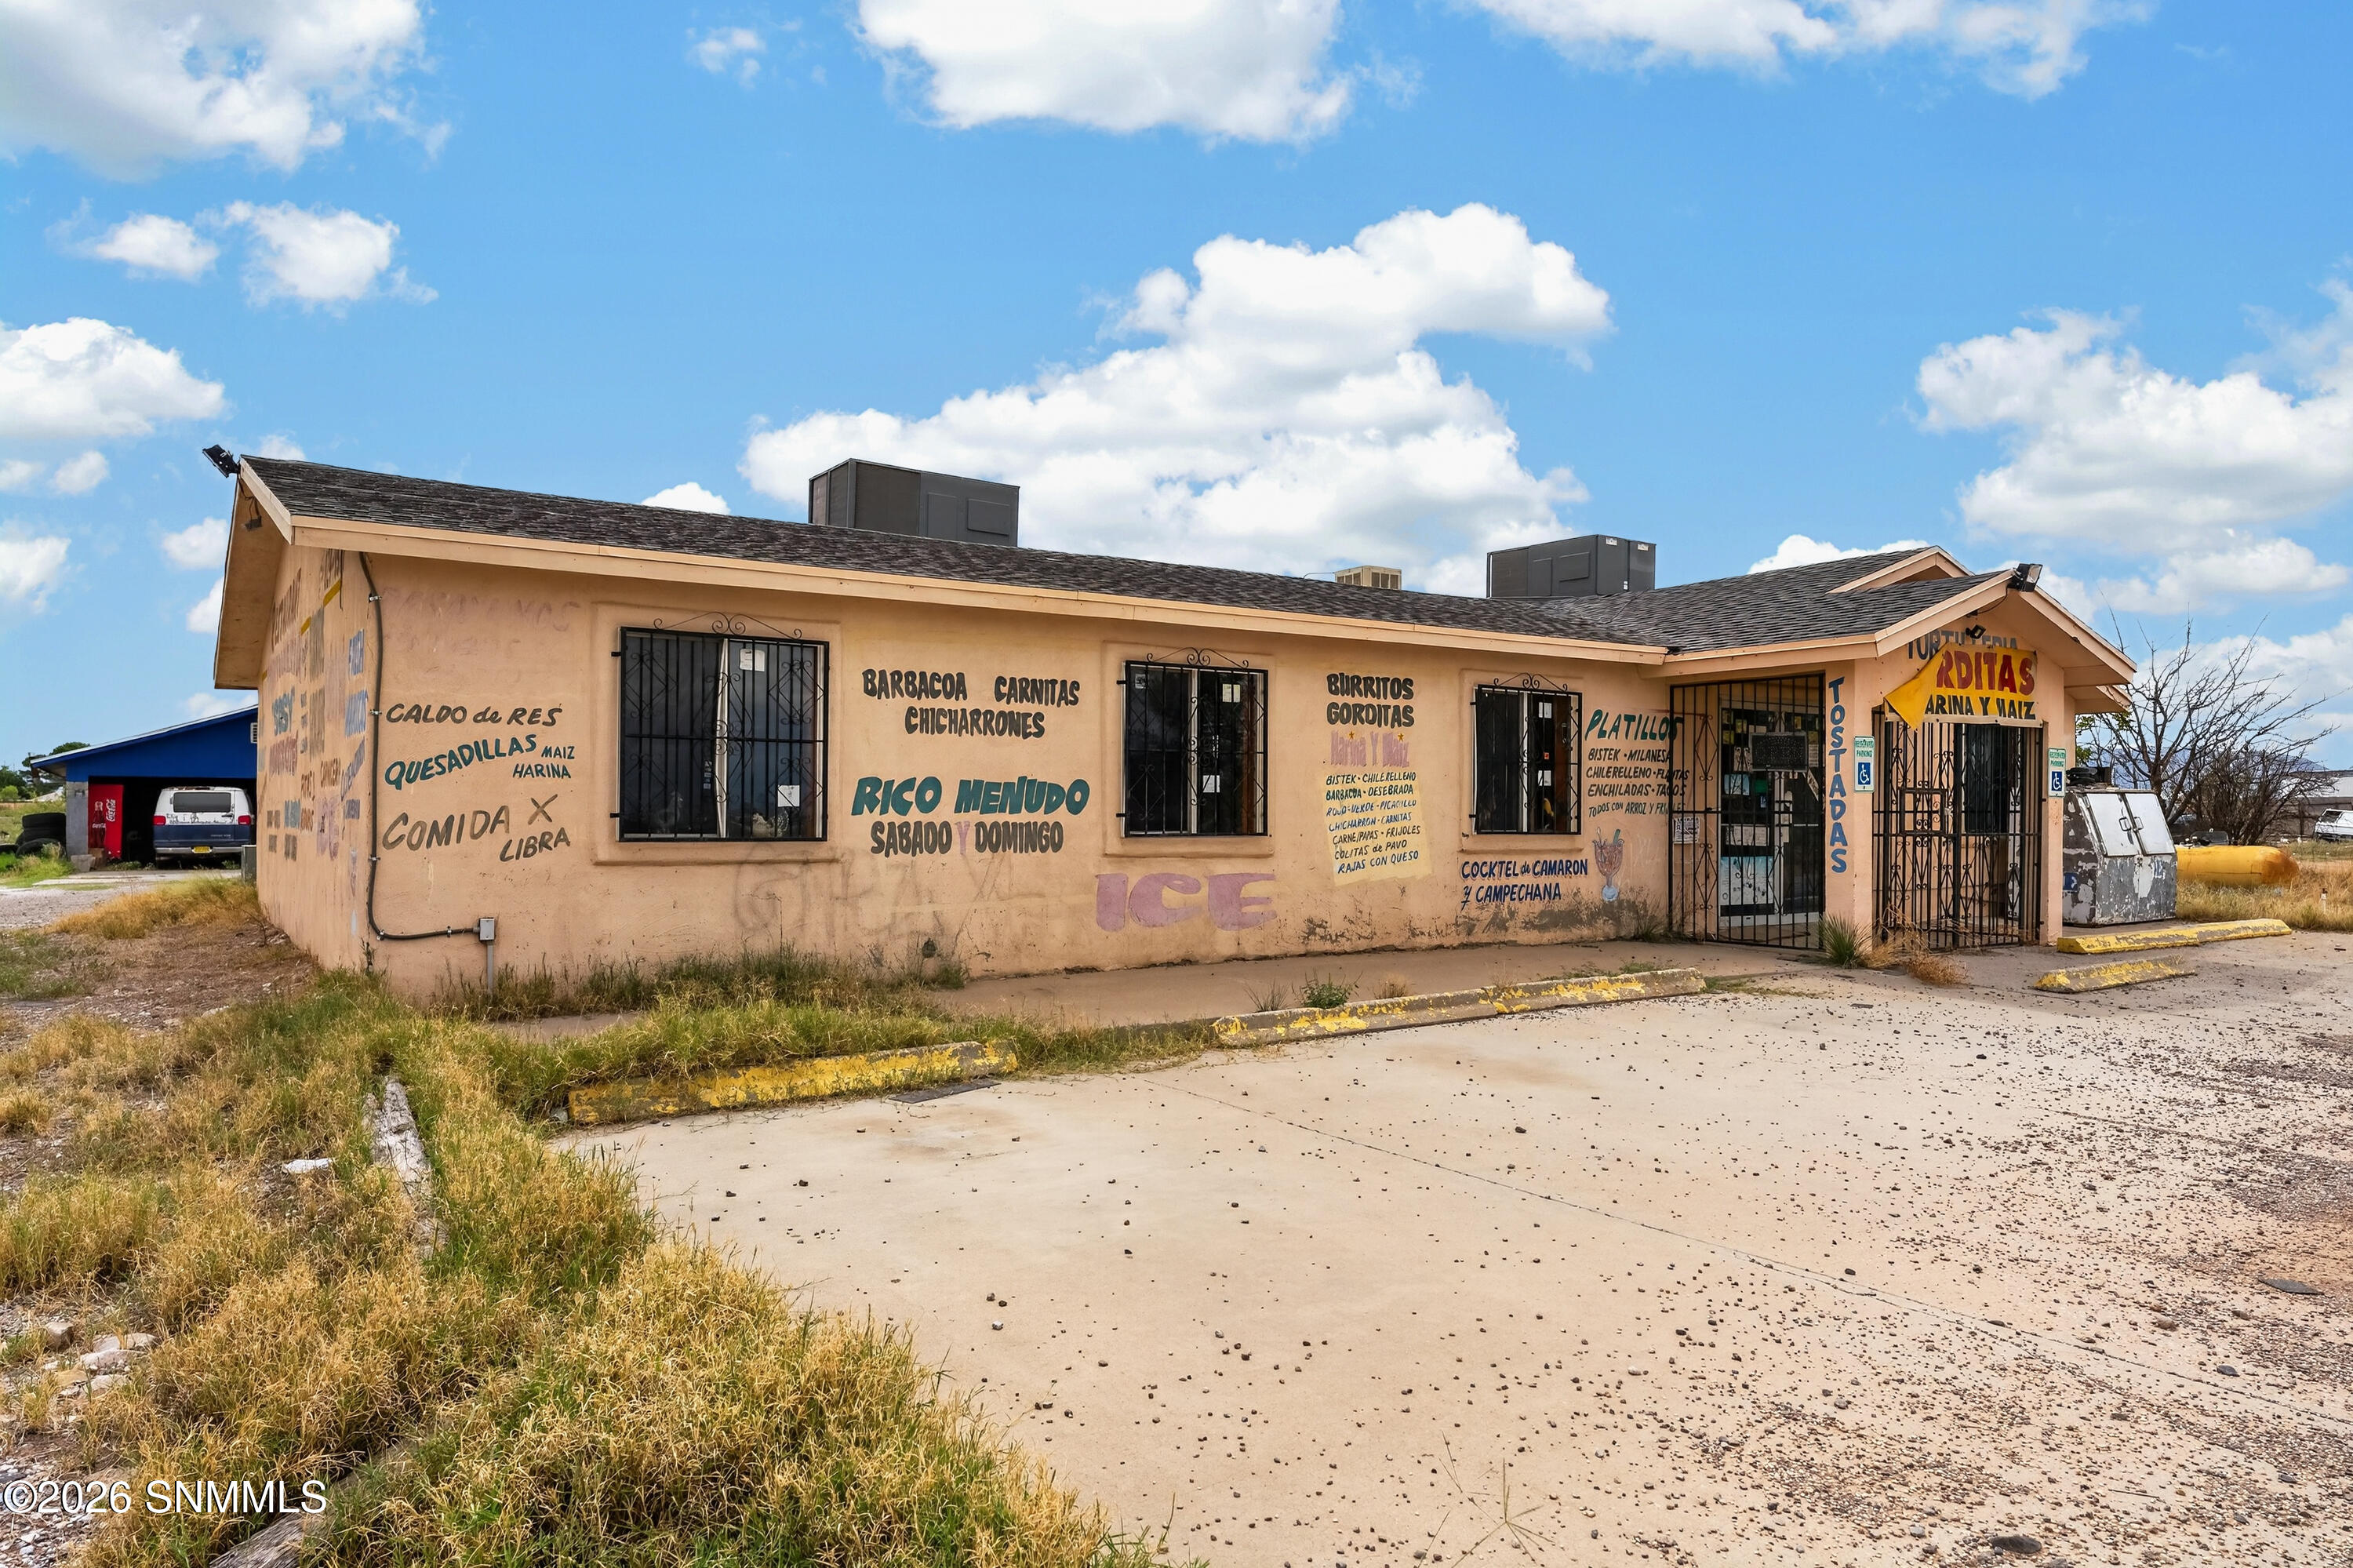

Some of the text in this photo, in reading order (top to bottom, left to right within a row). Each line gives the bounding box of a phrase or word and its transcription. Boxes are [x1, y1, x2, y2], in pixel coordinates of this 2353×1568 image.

[1936, 649, 2035, 696] RDITAS
[862, 669, 1080, 708] BARBACOA CARNITAS
[1326, 673, 1414, 700] BURRITOS
[386, 704, 562, 726] CALDO de RES
[1326, 702, 1414, 729] GORDITAS
[1924, 694, 2036, 720] ARINA Y MAIZ
[905, 706, 1045, 739] CHICHARRONES
[1584, 709, 1684, 741] PLATILLOS
[1370, 731, 1379, 766] Y
[1587, 748, 1620, 762] BISTEK
[384, 734, 536, 790] QUESADILLAS
[541, 745, 575, 759] MAIZ
[512, 763, 571, 778] HARINA
[1828, 676, 1849, 873] TOSTADAS
[1326, 774, 1357, 785] BISTEK
[1326, 784, 1413, 801] BARBACOA DESEBRADA
[1587, 784, 1651, 797] ENCHILADAS
[851, 776, 1090, 816] RICO MENUDO
[382, 805, 511, 851] COMIDA
[527, 794, 558, 824] X
[1381, 812, 1412, 824] CARNITAS
[1589, 802, 1610, 817] TODOS
[1625, 802, 1646, 815] ARROZ
[1649, 802, 1654, 814] Y
[499, 827, 571, 862] LIBRA
[871, 820, 1064, 857] SABADO Y DOMINGO
[1386, 825, 1420, 839] FRIJOLES
[1335, 839, 1407, 860] COLITAS de PAVO
[1338, 850, 1419, 874] RAJAS CON QUESO
[1461, 860, 1519, 879] COCKTEL
[1532, 858, 1588, 876] CAMARON
[1095, 872, 1276, 932] ICE
[1475, 882, 1562, 903] CAMPECHANA
